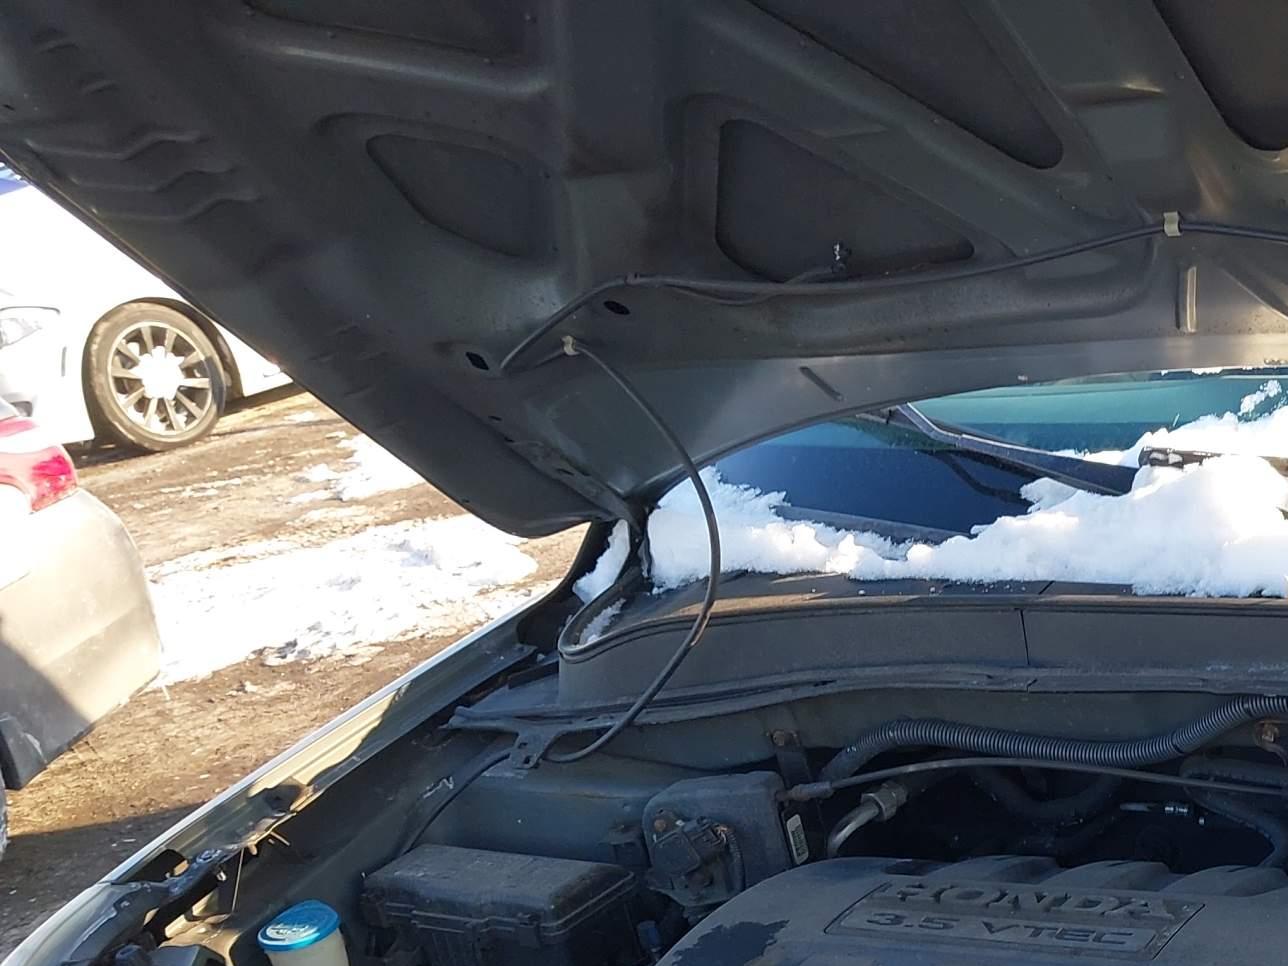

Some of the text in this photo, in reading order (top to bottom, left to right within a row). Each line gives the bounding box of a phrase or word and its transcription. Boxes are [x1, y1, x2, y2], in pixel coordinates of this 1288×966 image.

[896, 882, 1175, 920] HONDA
[866, 911, 1136, 946] 3.5 VTEC
